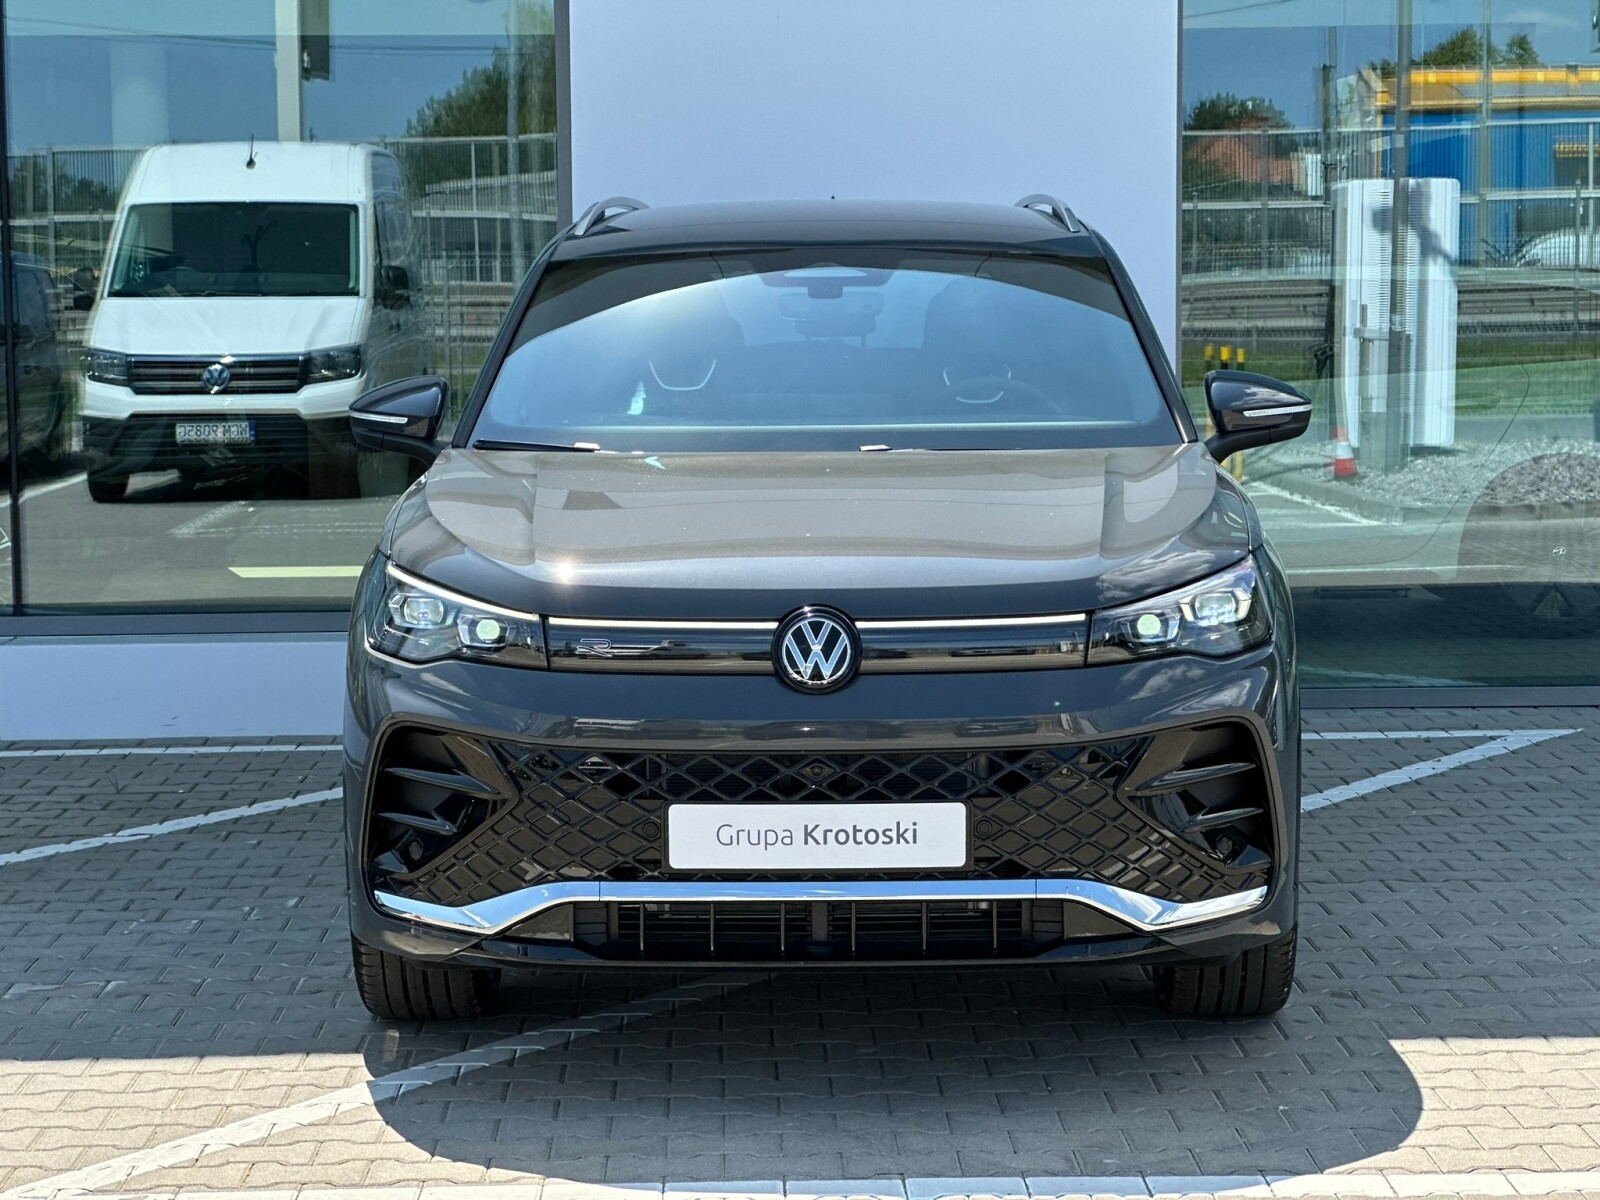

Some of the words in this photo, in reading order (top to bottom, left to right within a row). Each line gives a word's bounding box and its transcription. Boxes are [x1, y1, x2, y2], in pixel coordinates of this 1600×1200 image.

[783, 618, 850, 683] VW
[716, 824, 794, 851] Grupa
[803, 821, 918, 846] Krotoski
